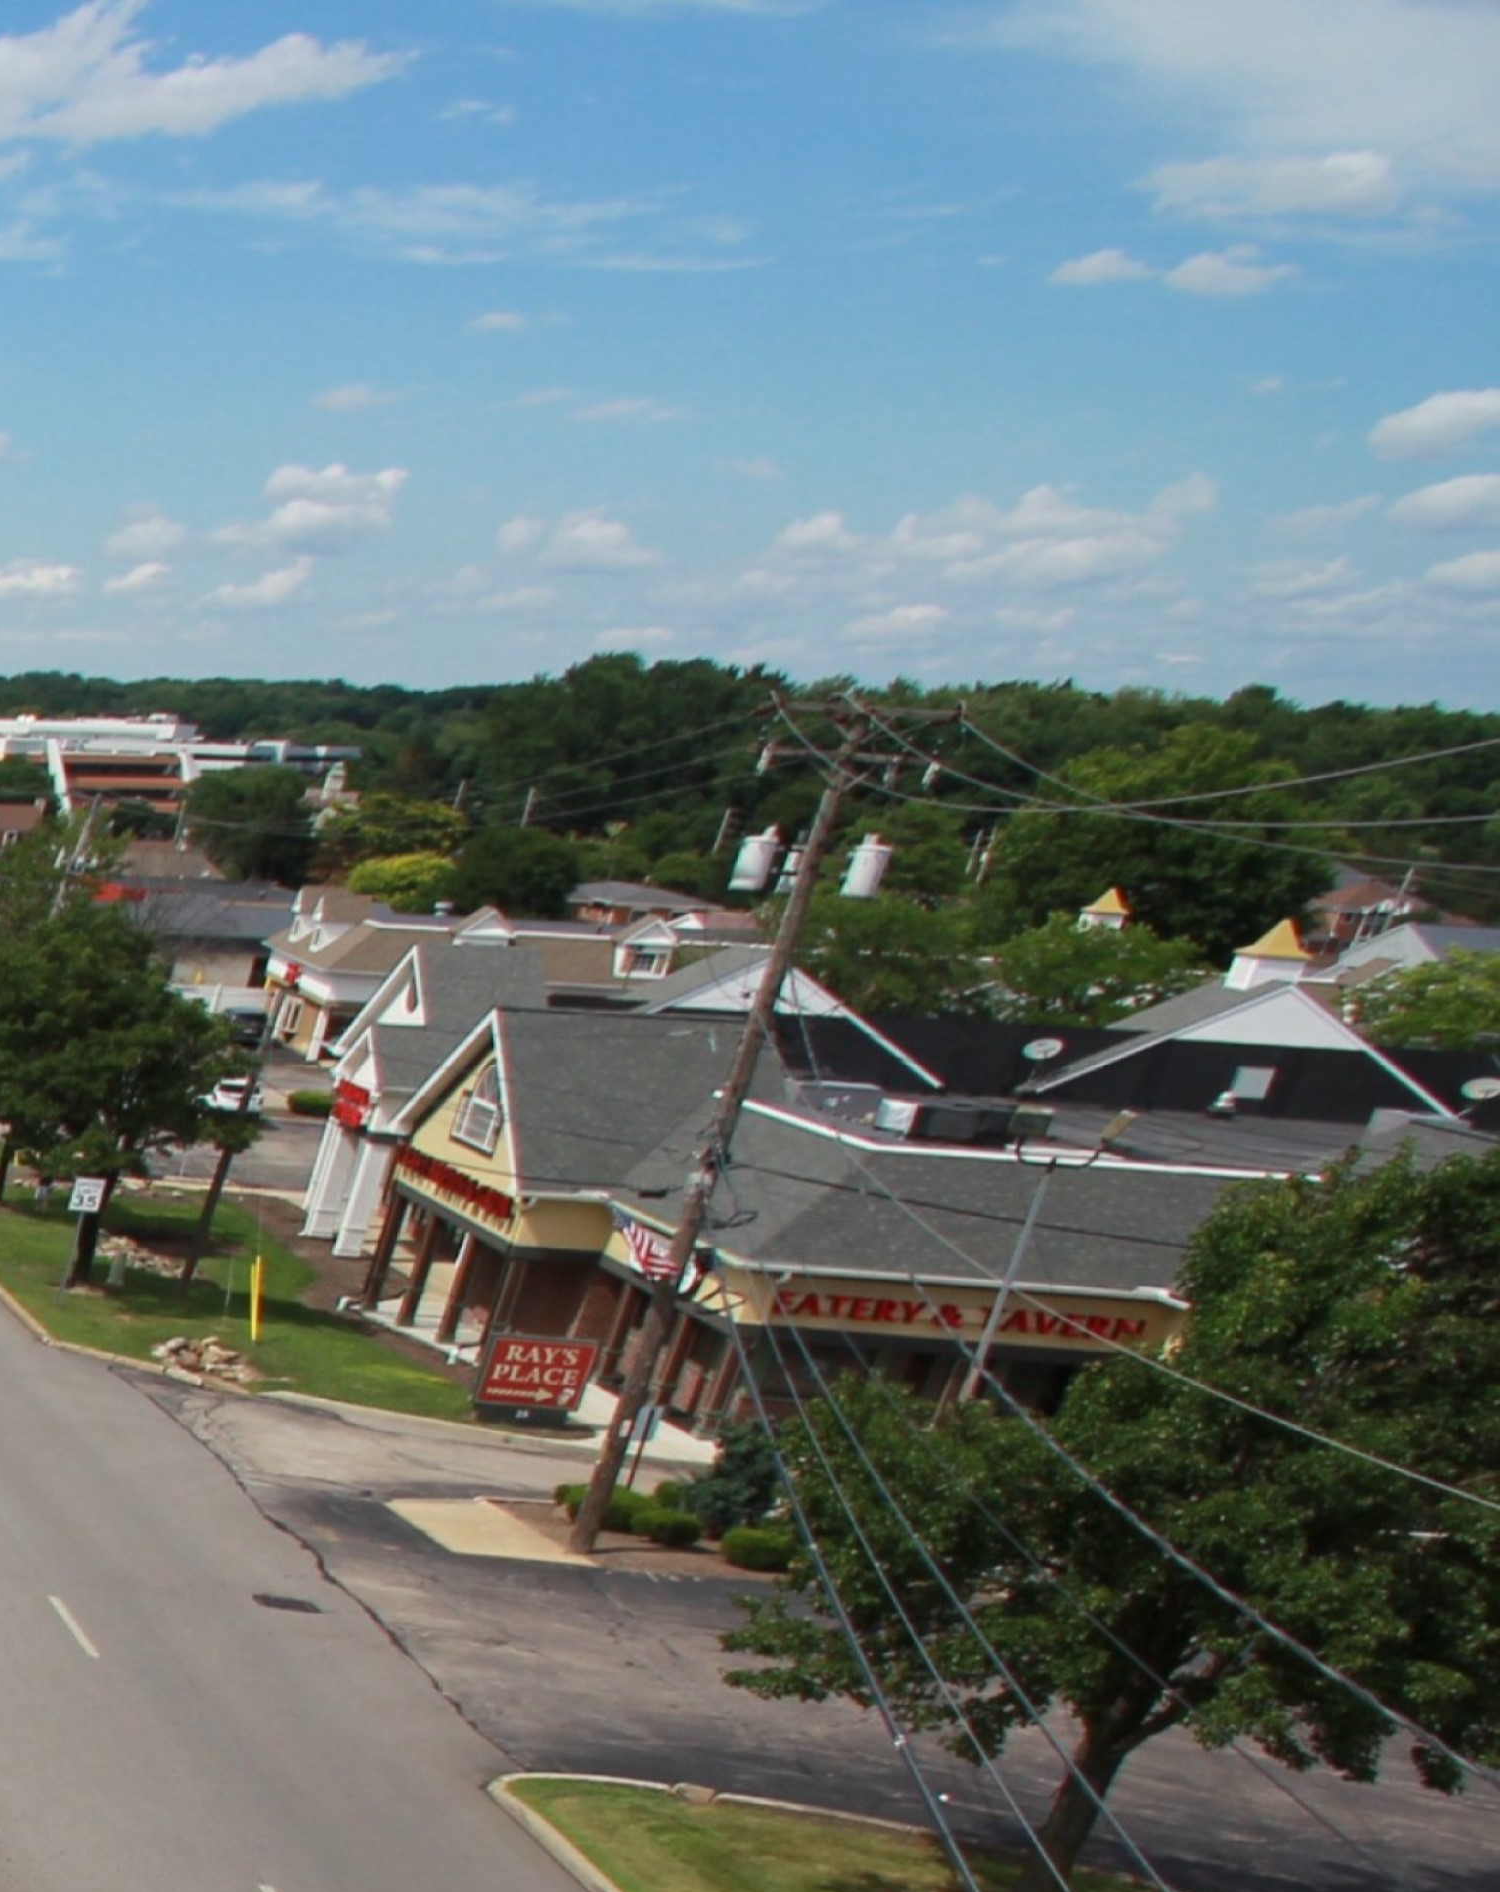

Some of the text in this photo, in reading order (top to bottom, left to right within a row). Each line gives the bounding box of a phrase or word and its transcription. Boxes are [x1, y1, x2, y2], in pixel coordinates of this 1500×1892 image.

[72, 1194, 98, 1208] 35
[773, 1290, 928, 1325] EATERY
[932, 1303, 963, 1329] &
[505, 1344, 580, 1367] RAY'S
[491, 1363, 580, 1387] PLACE
